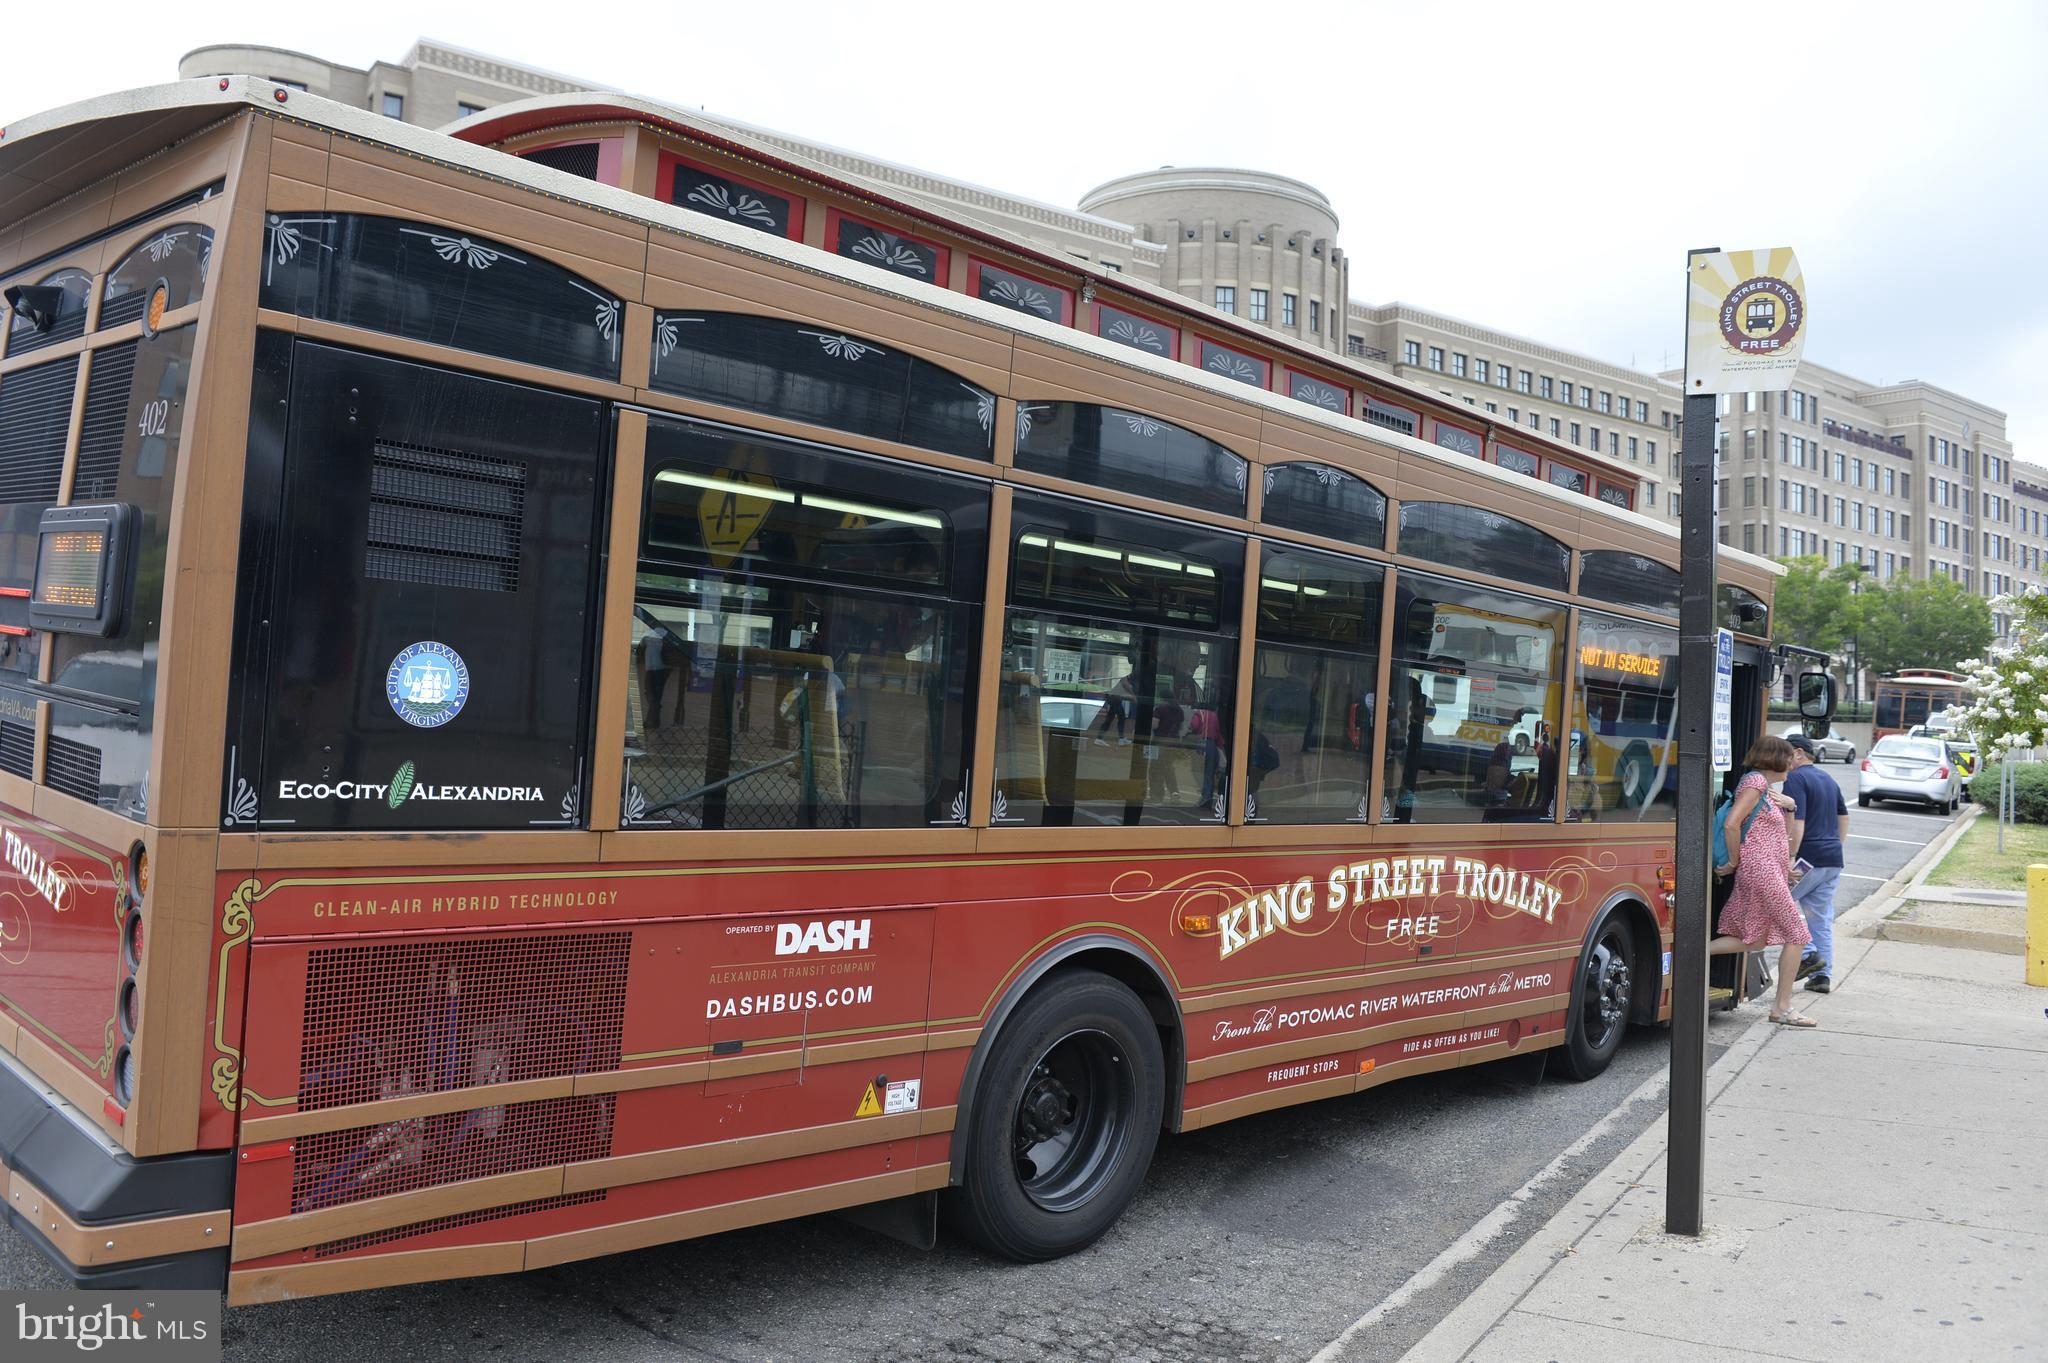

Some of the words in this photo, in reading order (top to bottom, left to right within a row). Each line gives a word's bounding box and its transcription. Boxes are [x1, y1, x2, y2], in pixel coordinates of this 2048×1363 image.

[1725, 306, 1734, 332] KING
[1731, 281, 1772, 303] STREET
[1775, 283, 1798, 329] TROLLEY
[1740, 339, 1780, 350] FREE
[139, 400, 168, 436] 402
[388, 663, 401, 695] CITY
[398, 647, 414, 664] OF
[417, 643, 467, 698] ALEXANDRIA
[1580, 646, 1603, 667] NOT
[1604, 650, 1617, 669] IN
[1618, 653, 1660, 677] SERVICE
[399, 704, 453, 725] VIRGINIA
[5, 828, 67, 912] TROLLEY
[313, 898, 423, 918] CLEAN-AIR
[432, 896, 500, 913] HYBRID
[509, 891, 619, 910] TECHNOLOGY
[1219, 877, 1314, 960] KING
[1328, 855, 1446, 911] STREET
[1453, 856, 1564, 925] TROLLEY
[725, 926, 763, 935] OPERATED
[764, 924, 775, 933] BY
[775, 918, 871, 956] DASH
[1386, 915, 1440, 939] FREE
[709, 969, 778, 985] ALEXANDRIA
[783, 965, 825, 979] TRANSIT
[830, 961, 877, 975] COMPANY
[706, 985, 873, 1019] DASHBUS.COM
[1212, 1019, 1252, 1042] From
[1251, 1005, 1278, 1033] the
[1278, 1004, 1355, 1029] POTOMAC
[1359, 996, 1399, 1018] RIVER
[1401, 983, 1487, 1008] WATERFRONT
[1497, 971, 1515, 994] the
[1514, 973, 1551, 991] METRO
[1403, 1041, 1421, 1054] RIDE
[1422, 1038, 1432, 1050] AS
[1434, 1035, 1458, 1049] OFTEN
[1459, 1033, 1468, 1045] AS
[1470, 1031, 1482, 1043] YOU
[1483, 1028, 1500, 1041] LIKE!
[1267, 1065, 1310, 1083] FREQUENT
[1312, 1059, 1340, 1075] STOPS
